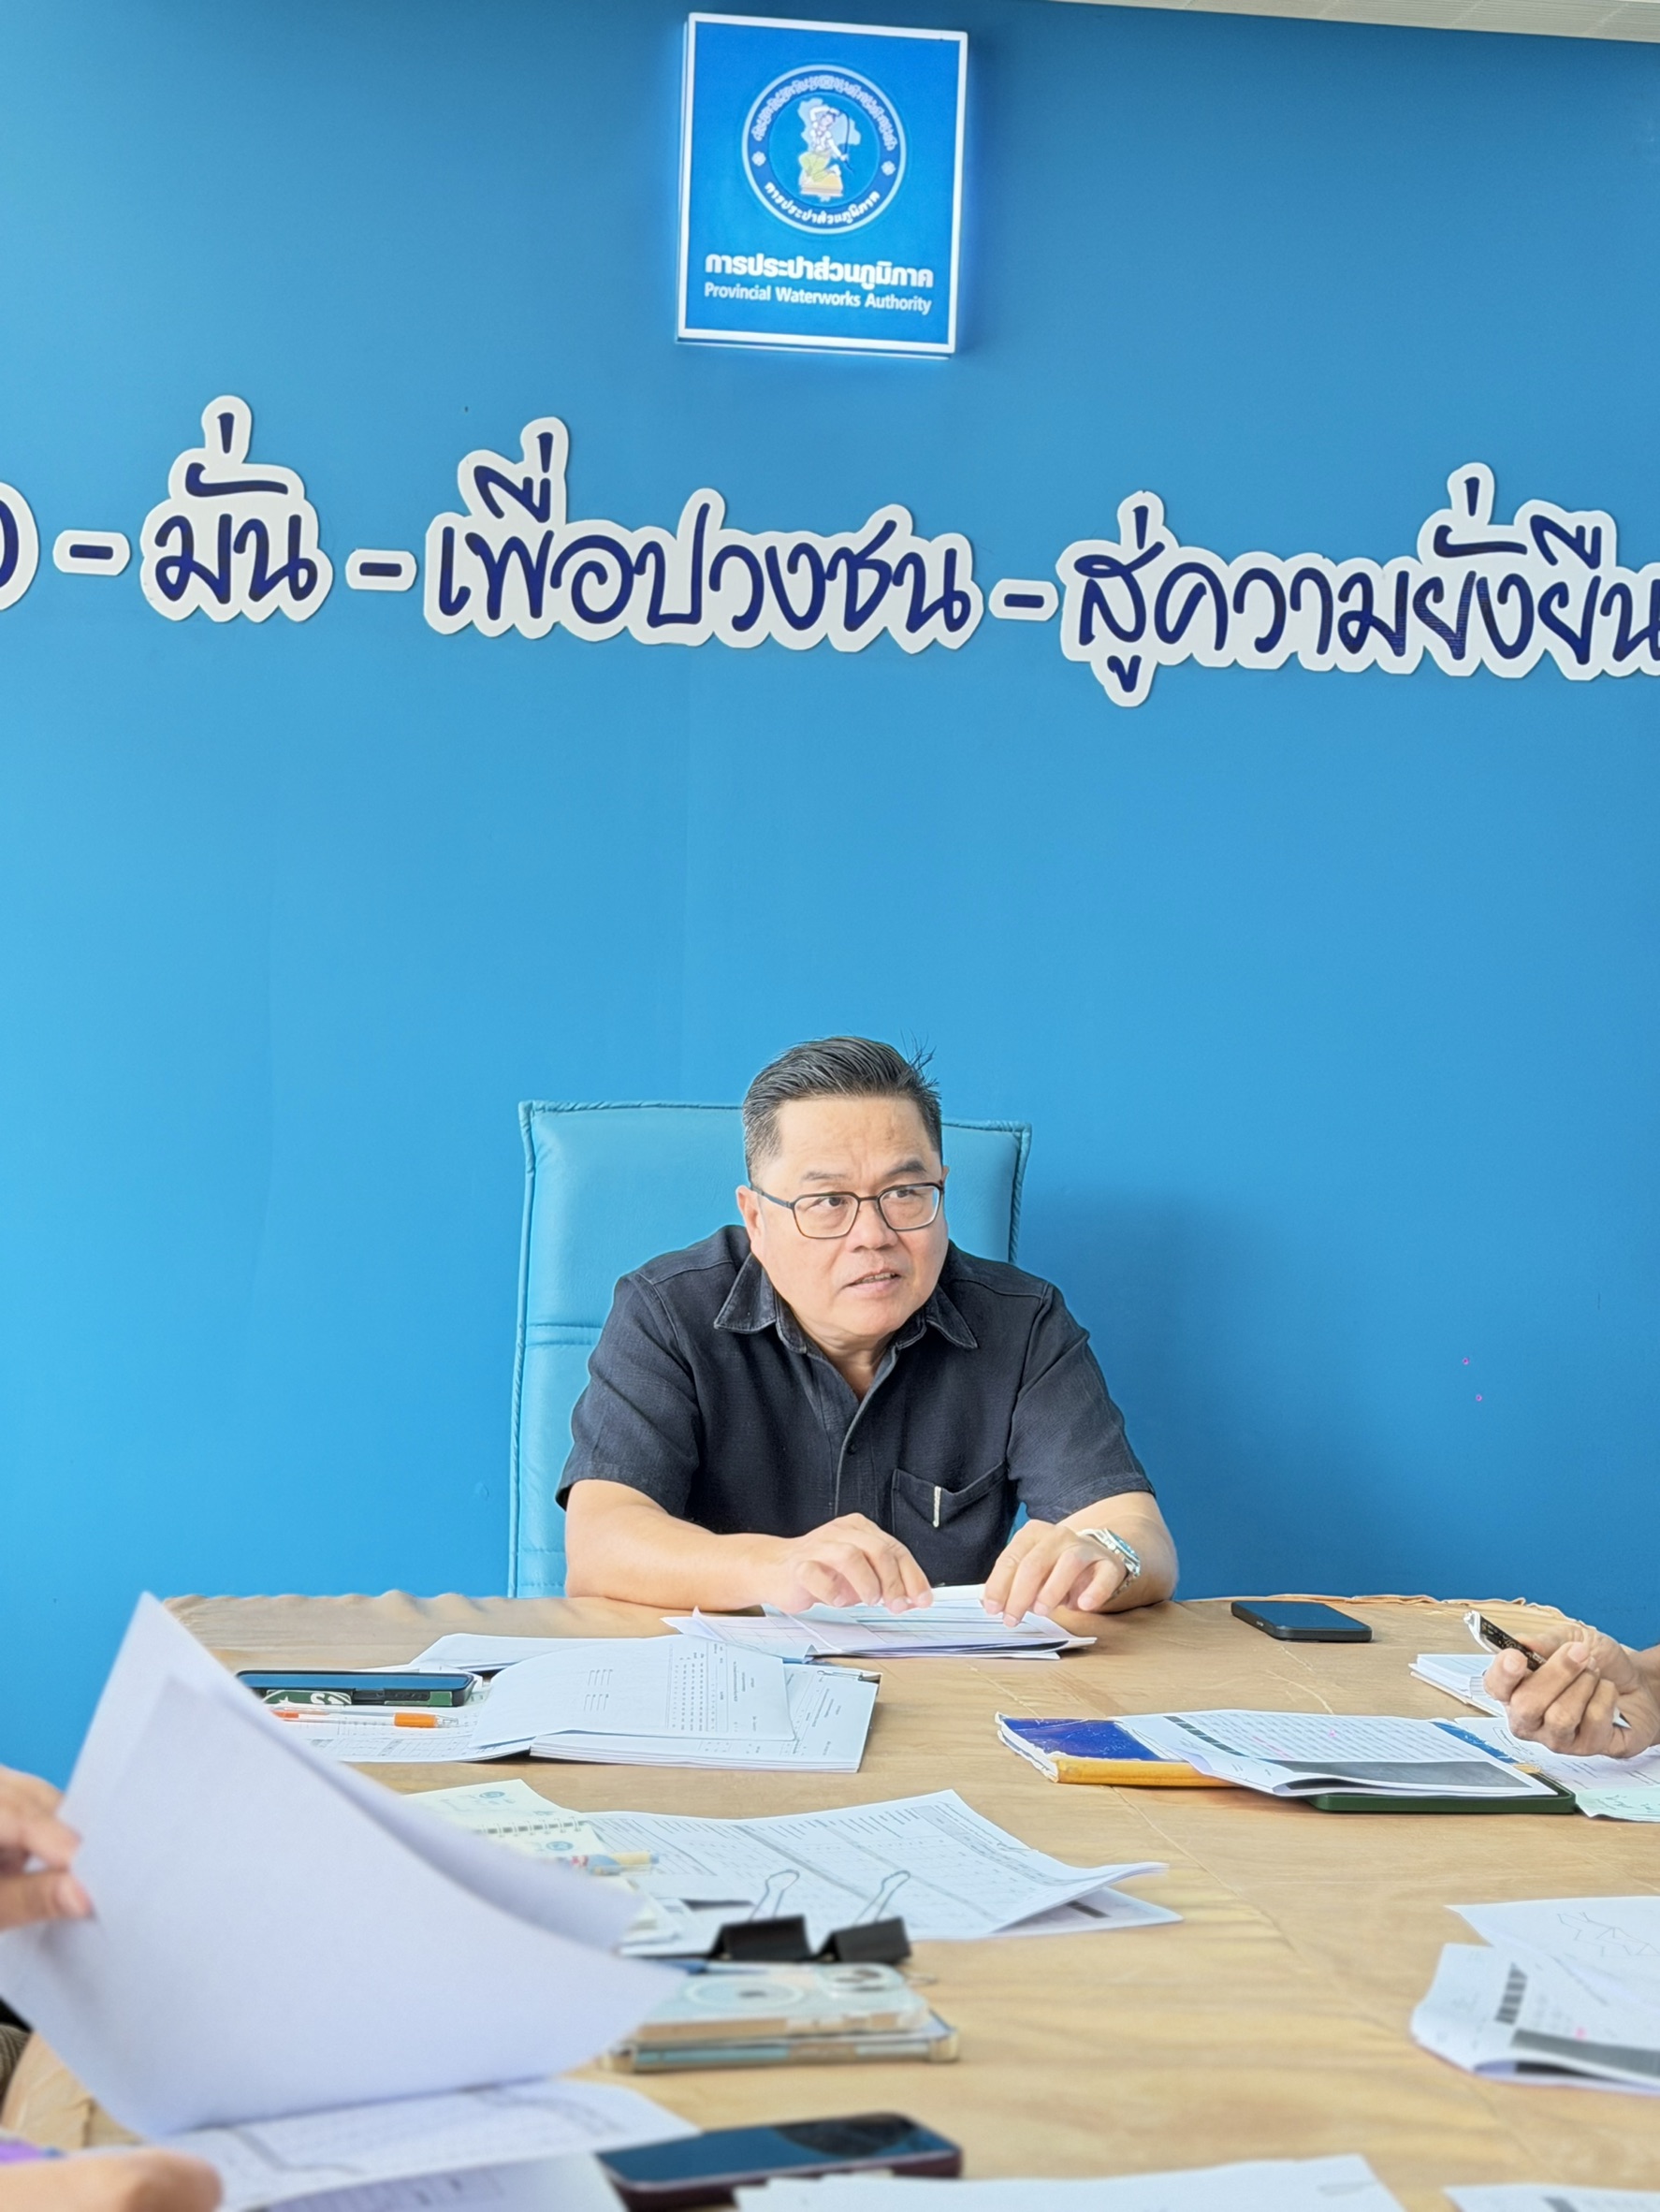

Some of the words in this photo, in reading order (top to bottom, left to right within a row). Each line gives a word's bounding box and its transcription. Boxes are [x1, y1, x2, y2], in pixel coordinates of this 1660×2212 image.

[705, 253, 934, 290] การประปาส่วนภูมิภาค
[705, 282, 771, 300] Provincial
[775, 286, 861, 307] Waterworks
[864, 293, 932, 315] Authority
